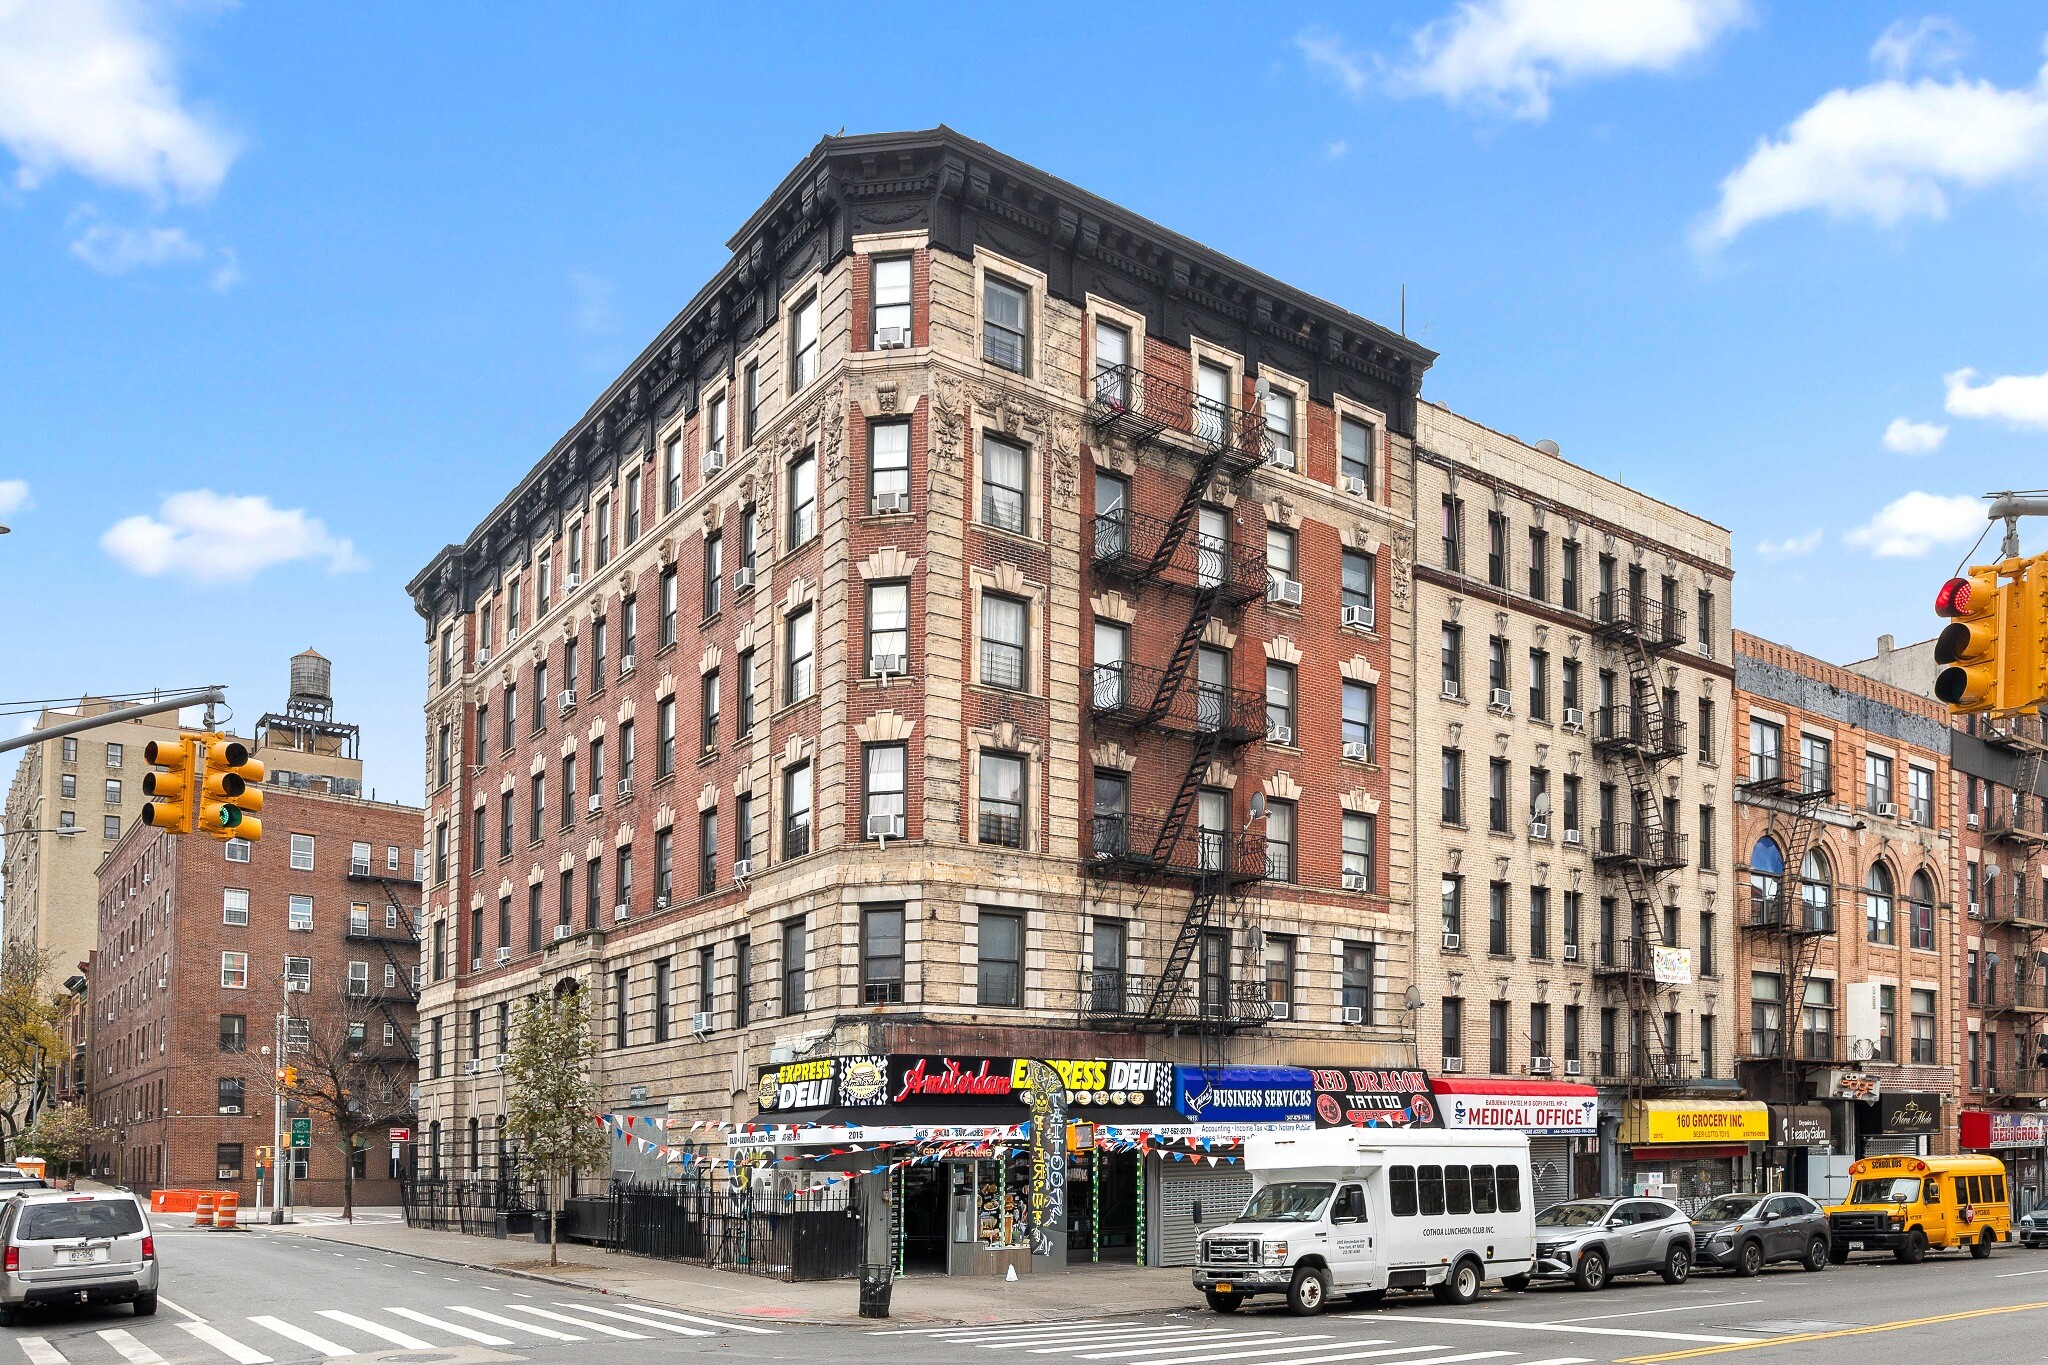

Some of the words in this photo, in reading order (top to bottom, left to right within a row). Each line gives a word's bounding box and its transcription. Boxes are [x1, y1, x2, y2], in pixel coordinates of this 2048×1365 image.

[779, 1060, 834, 1083] EXPRESS
[894, 1058, 1012, 1102] Amsterdam
[1011, 1059, 1107, 1090] ERESS
[1109, 1062, 1156, 1090] DELI
[1310, 1070, 1347, 1091] RED
[1350, 1071, 1429, 1093] DRAGON
[779, 1079, 833, 1109] DELI
[1213, 1089, 1262, 1107] BUSINESS
[1265, 1090, 1311, 1107] SERVICES
[1346, 1095, 1401, 1108] TATTOO
[1468, 1108, 1531, 1125] MEDICAL
[1536, 1109, 1582, 1125] OFFICE
[1677, 1114, 1690, 1127] 160
[1693, 1113, 1728, 1127] GROCERY
[1730, 1114, 1744, 1127] INC.
[848, 1131, 863, 1139] 2015
[915, 1129, 929, 1137] 2015
[1202, 1125, 1230, 1133] Accounting
[1810, 1127, 1825, 1139] Salon
[1872, 1160, 1891, 1169] SCHOOL
[1892, 1160, 1901, 1168] BUS
[1445, 1227, 1471, 1235] LUNCHEON
[1472, 1226, 1484, 1234] CLUB
